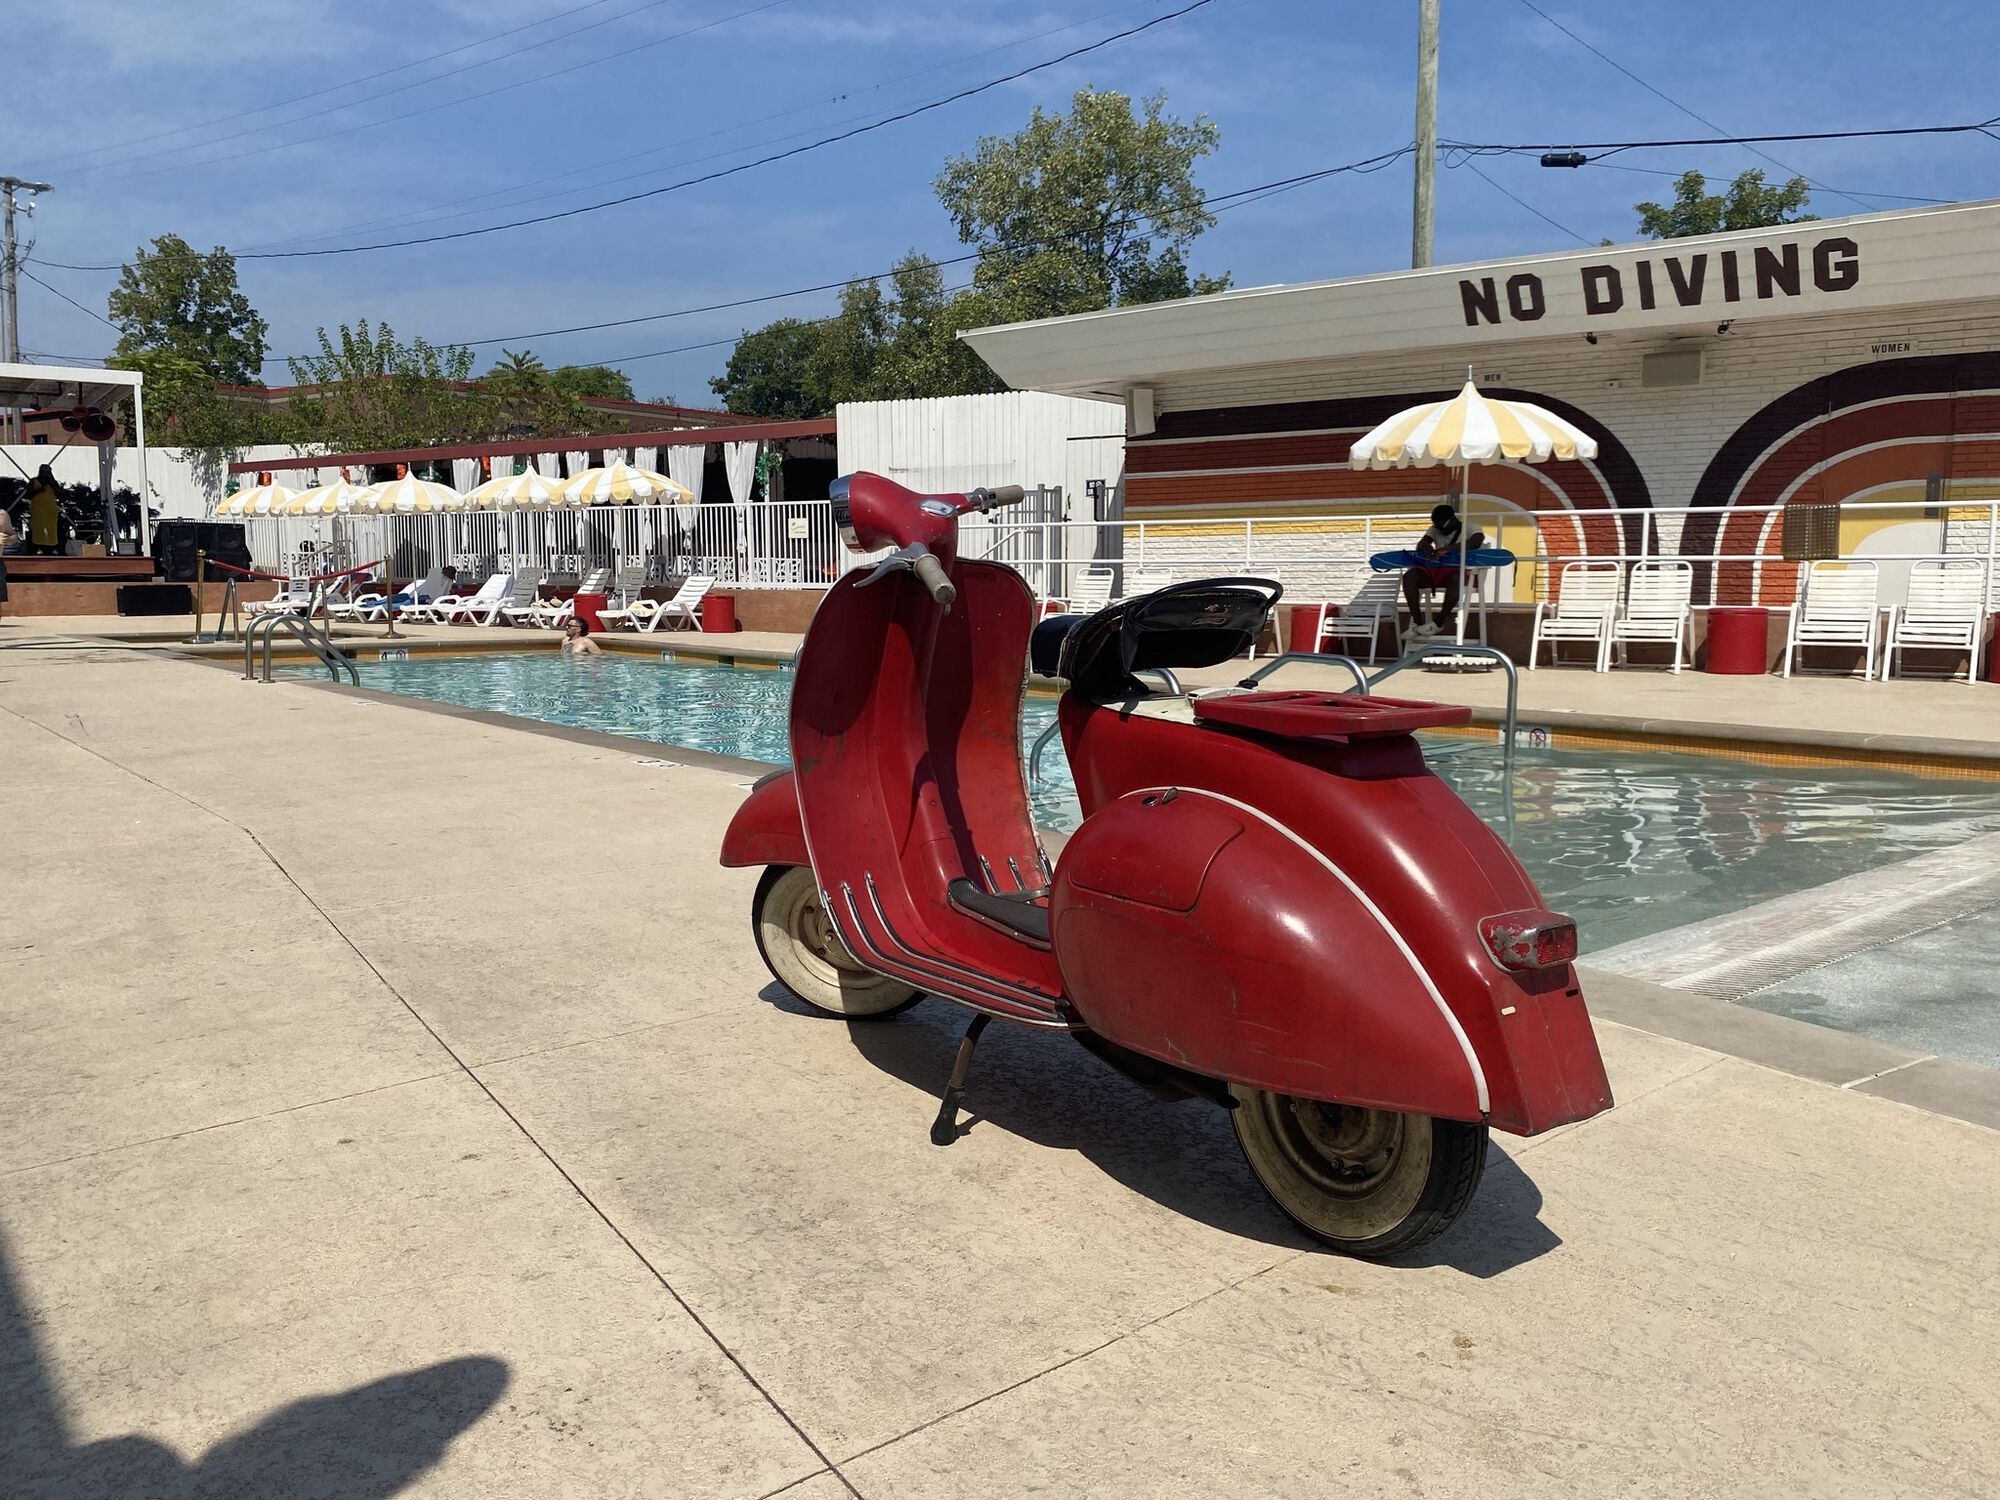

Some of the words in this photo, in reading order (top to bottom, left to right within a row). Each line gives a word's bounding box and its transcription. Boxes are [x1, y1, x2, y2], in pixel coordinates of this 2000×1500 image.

[1459, 273, 1545, 326] NO
[1581, 237, 1859, 315] DIVING
[1871, 343, 1911, 354] WOMEN
[1484, 373, 1501, 382] MEN
